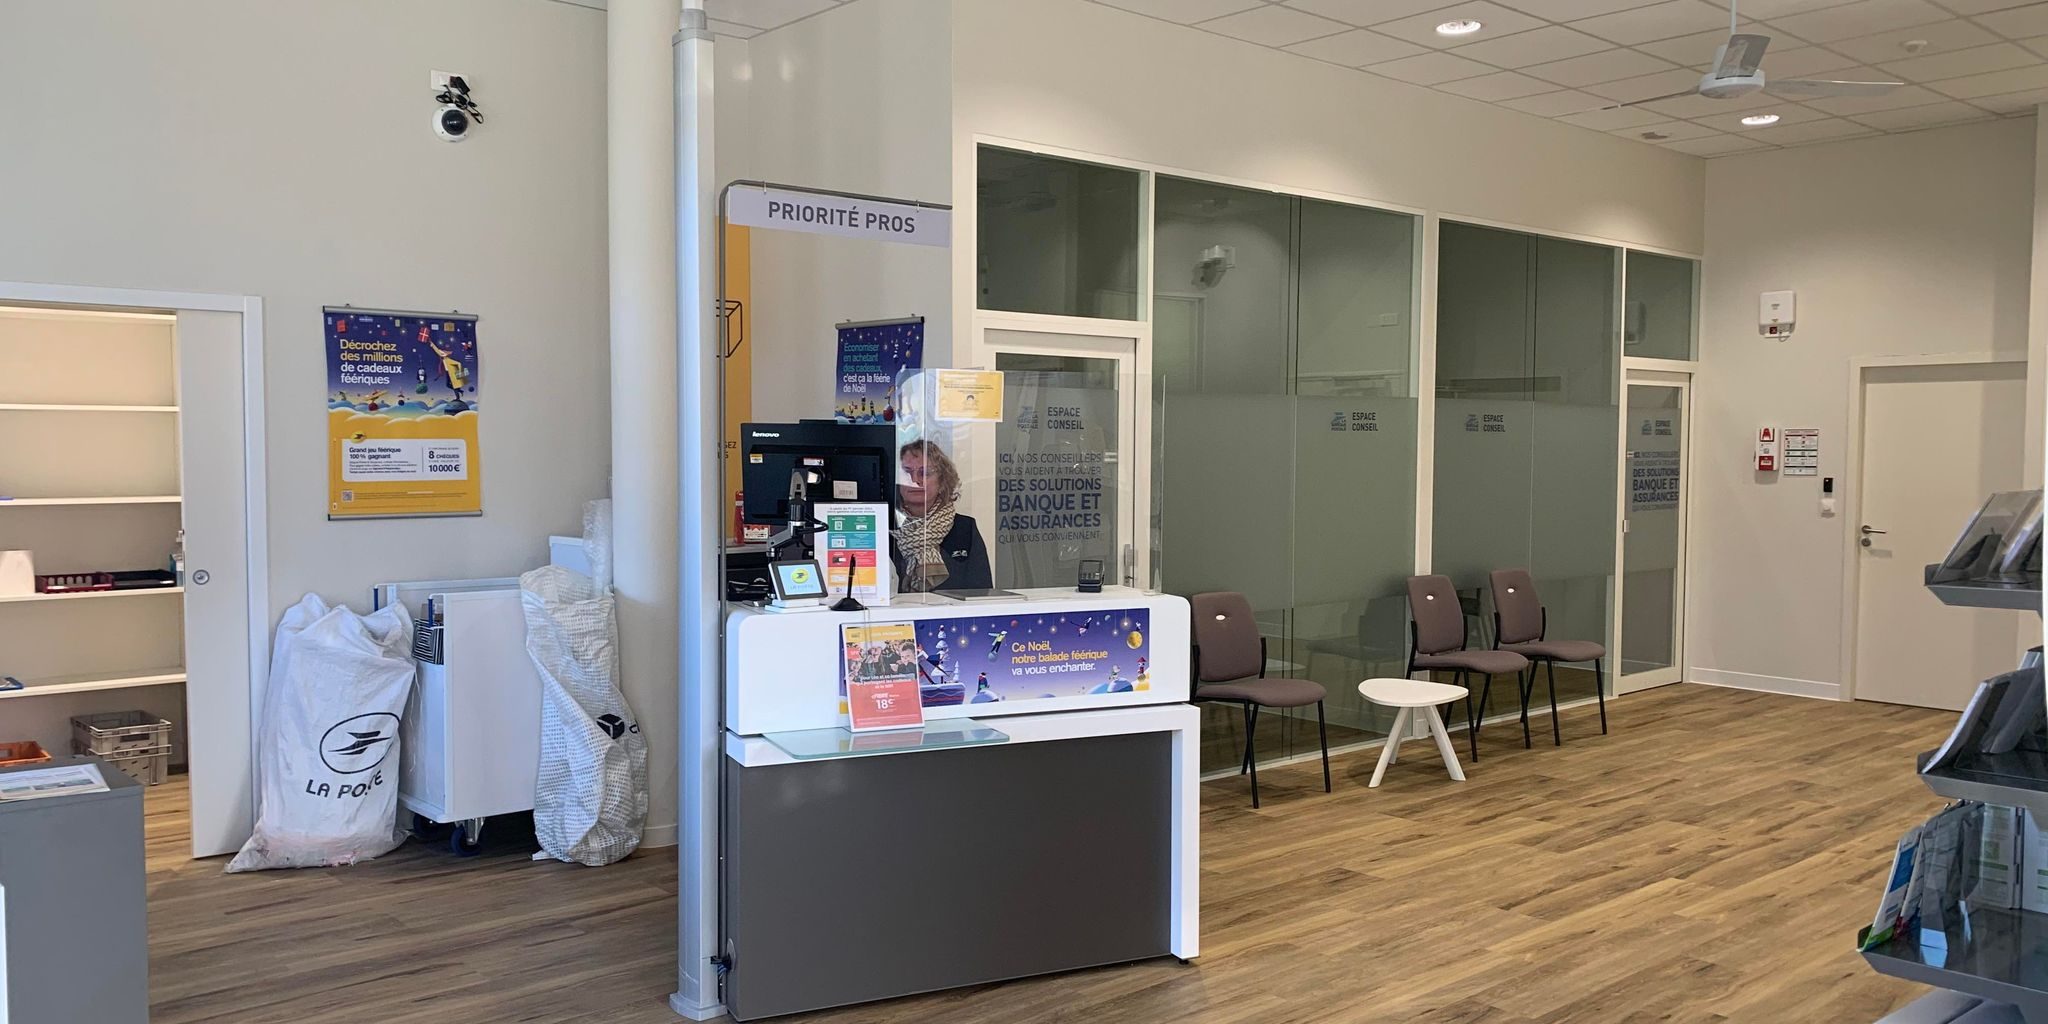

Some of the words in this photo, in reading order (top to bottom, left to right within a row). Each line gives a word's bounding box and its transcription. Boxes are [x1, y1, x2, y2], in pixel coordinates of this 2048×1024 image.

[768, 201, 859, 228] PRIORITÉ
[865, 212, 915, 234] PROS
[340, 339, 397, 351] Décrochez
[843, 343, 879, 352] Économiser
[340, 351, 360, 361] des
[363, 352, 403, 363] millions
[852, 353, 879, 362] achetant
[341, 362, 355, 372] de
[357, 363, 402, 374] cadeaux
[843, 363, 855, 372] des
[341, 373, 390, 386] féériques
[843, 373, 858, 383] c'est
[858, 375, 866, 384] ça
[866, 373, 873, 382] la
[843, 384, 851, 392] de
[852, 384, 866, 392] Noël
[1047, 407, 1081, 417] ESPACE
[1352, 412, 1377, 421] ESPACE
[1483, 414, 1504, 423] ESPACE
[1047, 420, 1085, 430] CONSEIL
[1352, 422, 1379, 431] CONSEIL
[1483, 424, 1506, 432] CONSEIL
[428, 450, 435, 459] 8
[1000, 453, 1014, 464] ICI,
[1017, 453, 1038, 463] NOS
[1040, 453, 1102, 463] CONSEILLERS
[1000, 467, 1023, 476] VOUS
[1024, 467, 1055, 476] AIDENT
[1633, 469, 1645, 478] DES
[1647, 468, 1679, 477] SOLUTIONS
[999, 479, 1025, 492] DES
[1029, 478, 1102, 491] SOLUTIONS
[1633, 478, 1667, 491] BANQUE
[1669, 478, 1679, 490] ET
[999, 494, 1075, 513] BANQUE
[1081, 493, 1102, 510] ET
[1632, 492, 1680, 503] ASSURANCES
[999, 513, 1101, 531] ASSURANCES
[999, 534, 1014, 545] QUI
[1017, 533, 1040, 543] VOUS
[1042, 531, 1101, 542] CONVIENNENT
[1012, 642, 1026, 653] Ce
[1028, 640, 1052, 651] Noël,
[1012, 654, 1036, 664] notre
[1039, 652, 1070, 662] balade
[1071, 650, 1108, 661] féérique
[1012, 668, 1023, 676] va
[1025, 666, 1047, 675] vous
[1049, 661, 1096, 673] enchanter.
[305, 779, 330, 798] LA
[337, 770, 383, 799] POE
